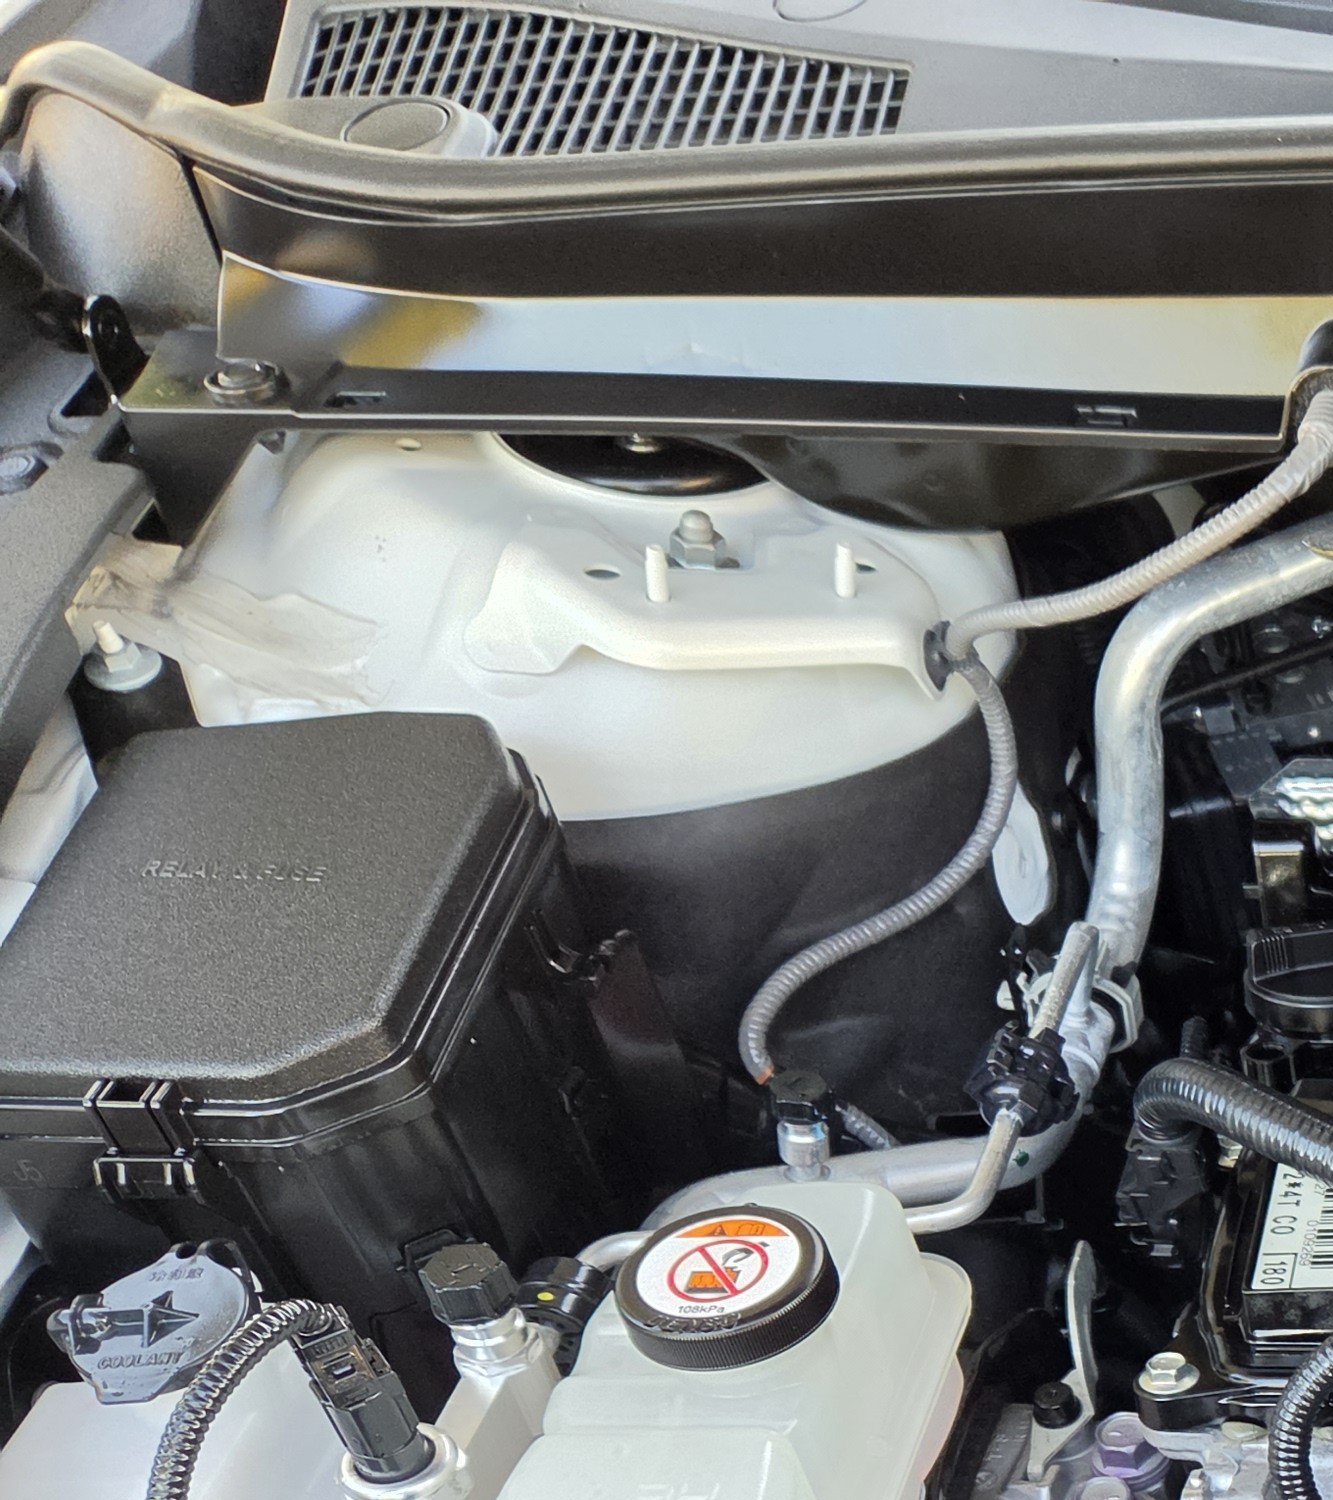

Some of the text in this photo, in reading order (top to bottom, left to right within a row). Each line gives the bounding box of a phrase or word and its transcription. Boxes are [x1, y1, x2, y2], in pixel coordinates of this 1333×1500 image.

[1260, 1260, 1288, 1285] 180
[677, 1304, 725, 1315] 108kPa
[97, 1351, 182, 1370] COOLANT
